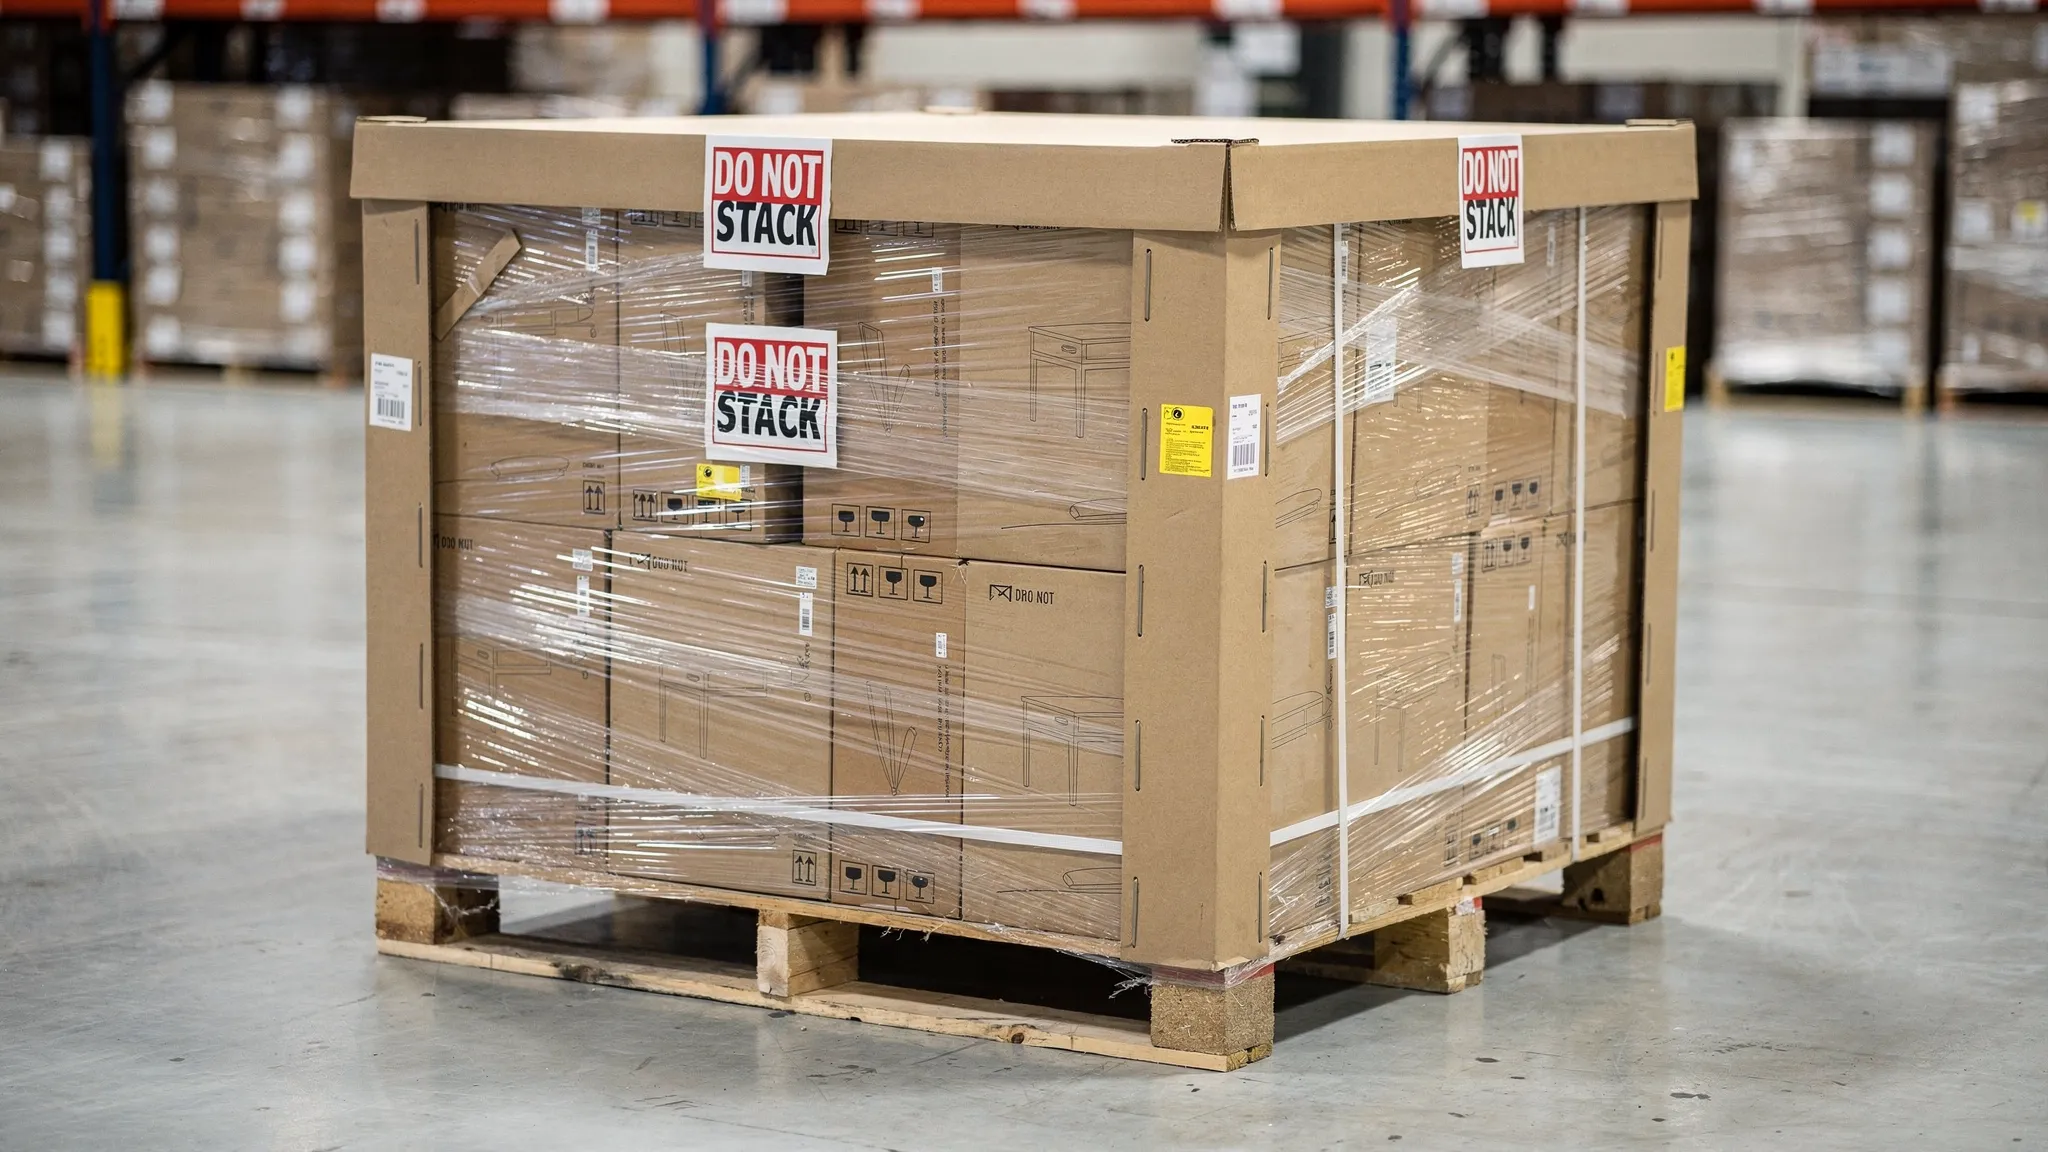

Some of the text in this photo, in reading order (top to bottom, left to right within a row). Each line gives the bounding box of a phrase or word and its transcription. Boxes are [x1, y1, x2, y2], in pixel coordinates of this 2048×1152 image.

[714, 150, 822, 199] DO NOT
[1463, 149, 1518, 195] DO NOT
[716, 199, 818, 247] STACK
[1466, 196, 1516, 241] STACK
[715, 341, 827, 392] DO NOT
[717, 390, 821, 440] STACK
[1036, 590, 1055, 605] NOT
